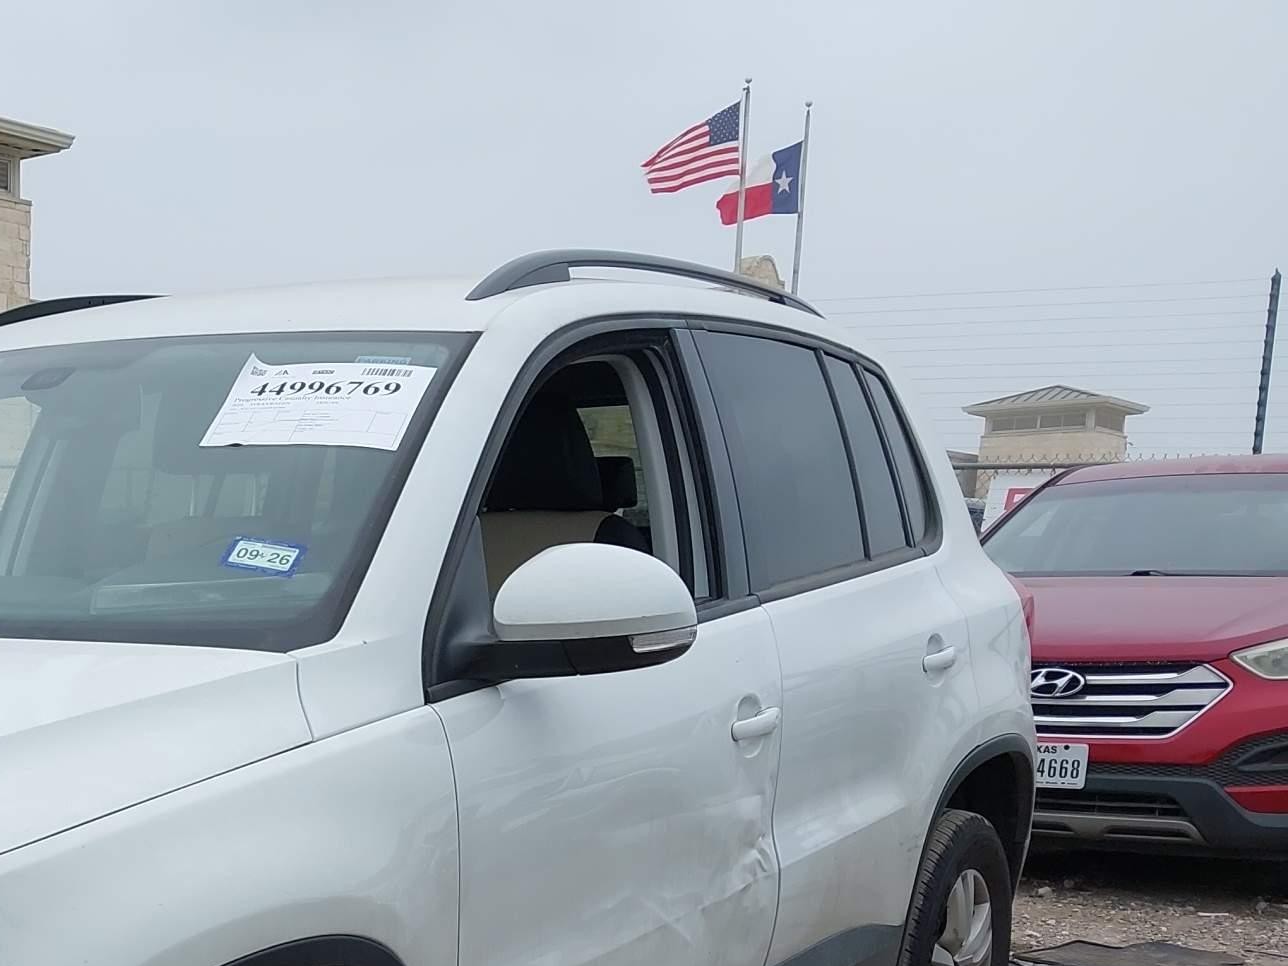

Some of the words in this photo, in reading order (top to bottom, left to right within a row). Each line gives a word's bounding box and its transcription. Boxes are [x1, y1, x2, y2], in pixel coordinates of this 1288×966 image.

[250, 380, 401, 396] 44996769
[236, 547, 260, 560] 09
[267, 552, 292, 566] 26
[1037, 745, 1058, 754] XAS
[1037, 758, 1081, 779] 4668
